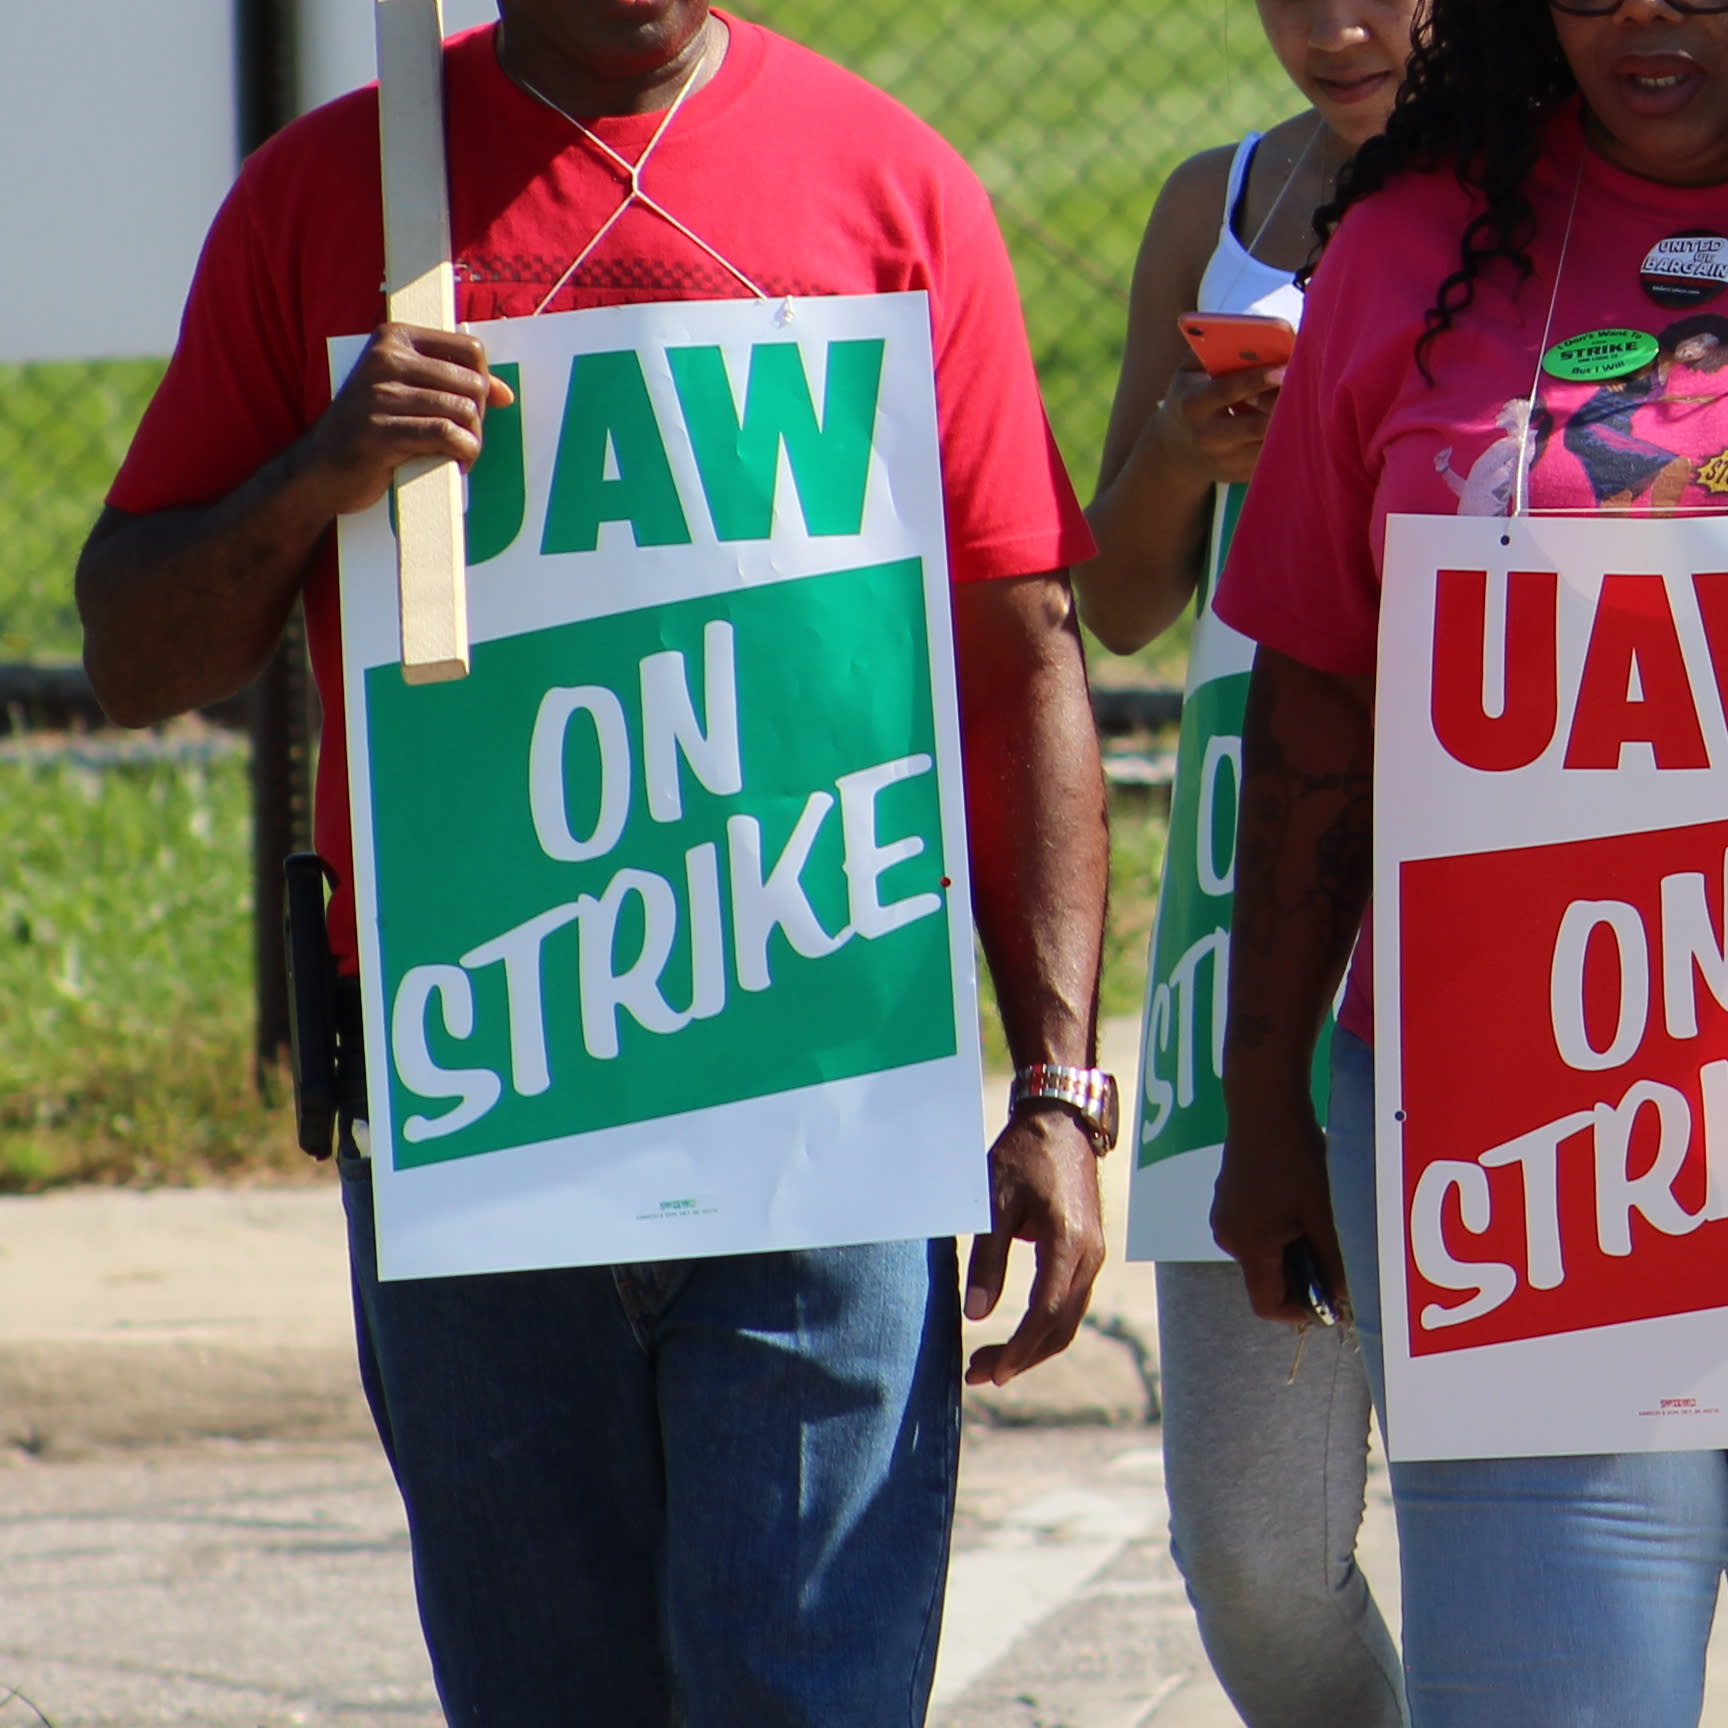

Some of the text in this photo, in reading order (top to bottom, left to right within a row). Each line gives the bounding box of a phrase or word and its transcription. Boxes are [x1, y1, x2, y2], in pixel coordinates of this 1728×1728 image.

[1658, 240, 1725, 253] UNITED
[1560, 341, 1638, 360] STRIKE
[529, 620, 742, 862] ON
[1196, 734, 1243, 898] O
[391, 753, 942, 1143] STRIKE
